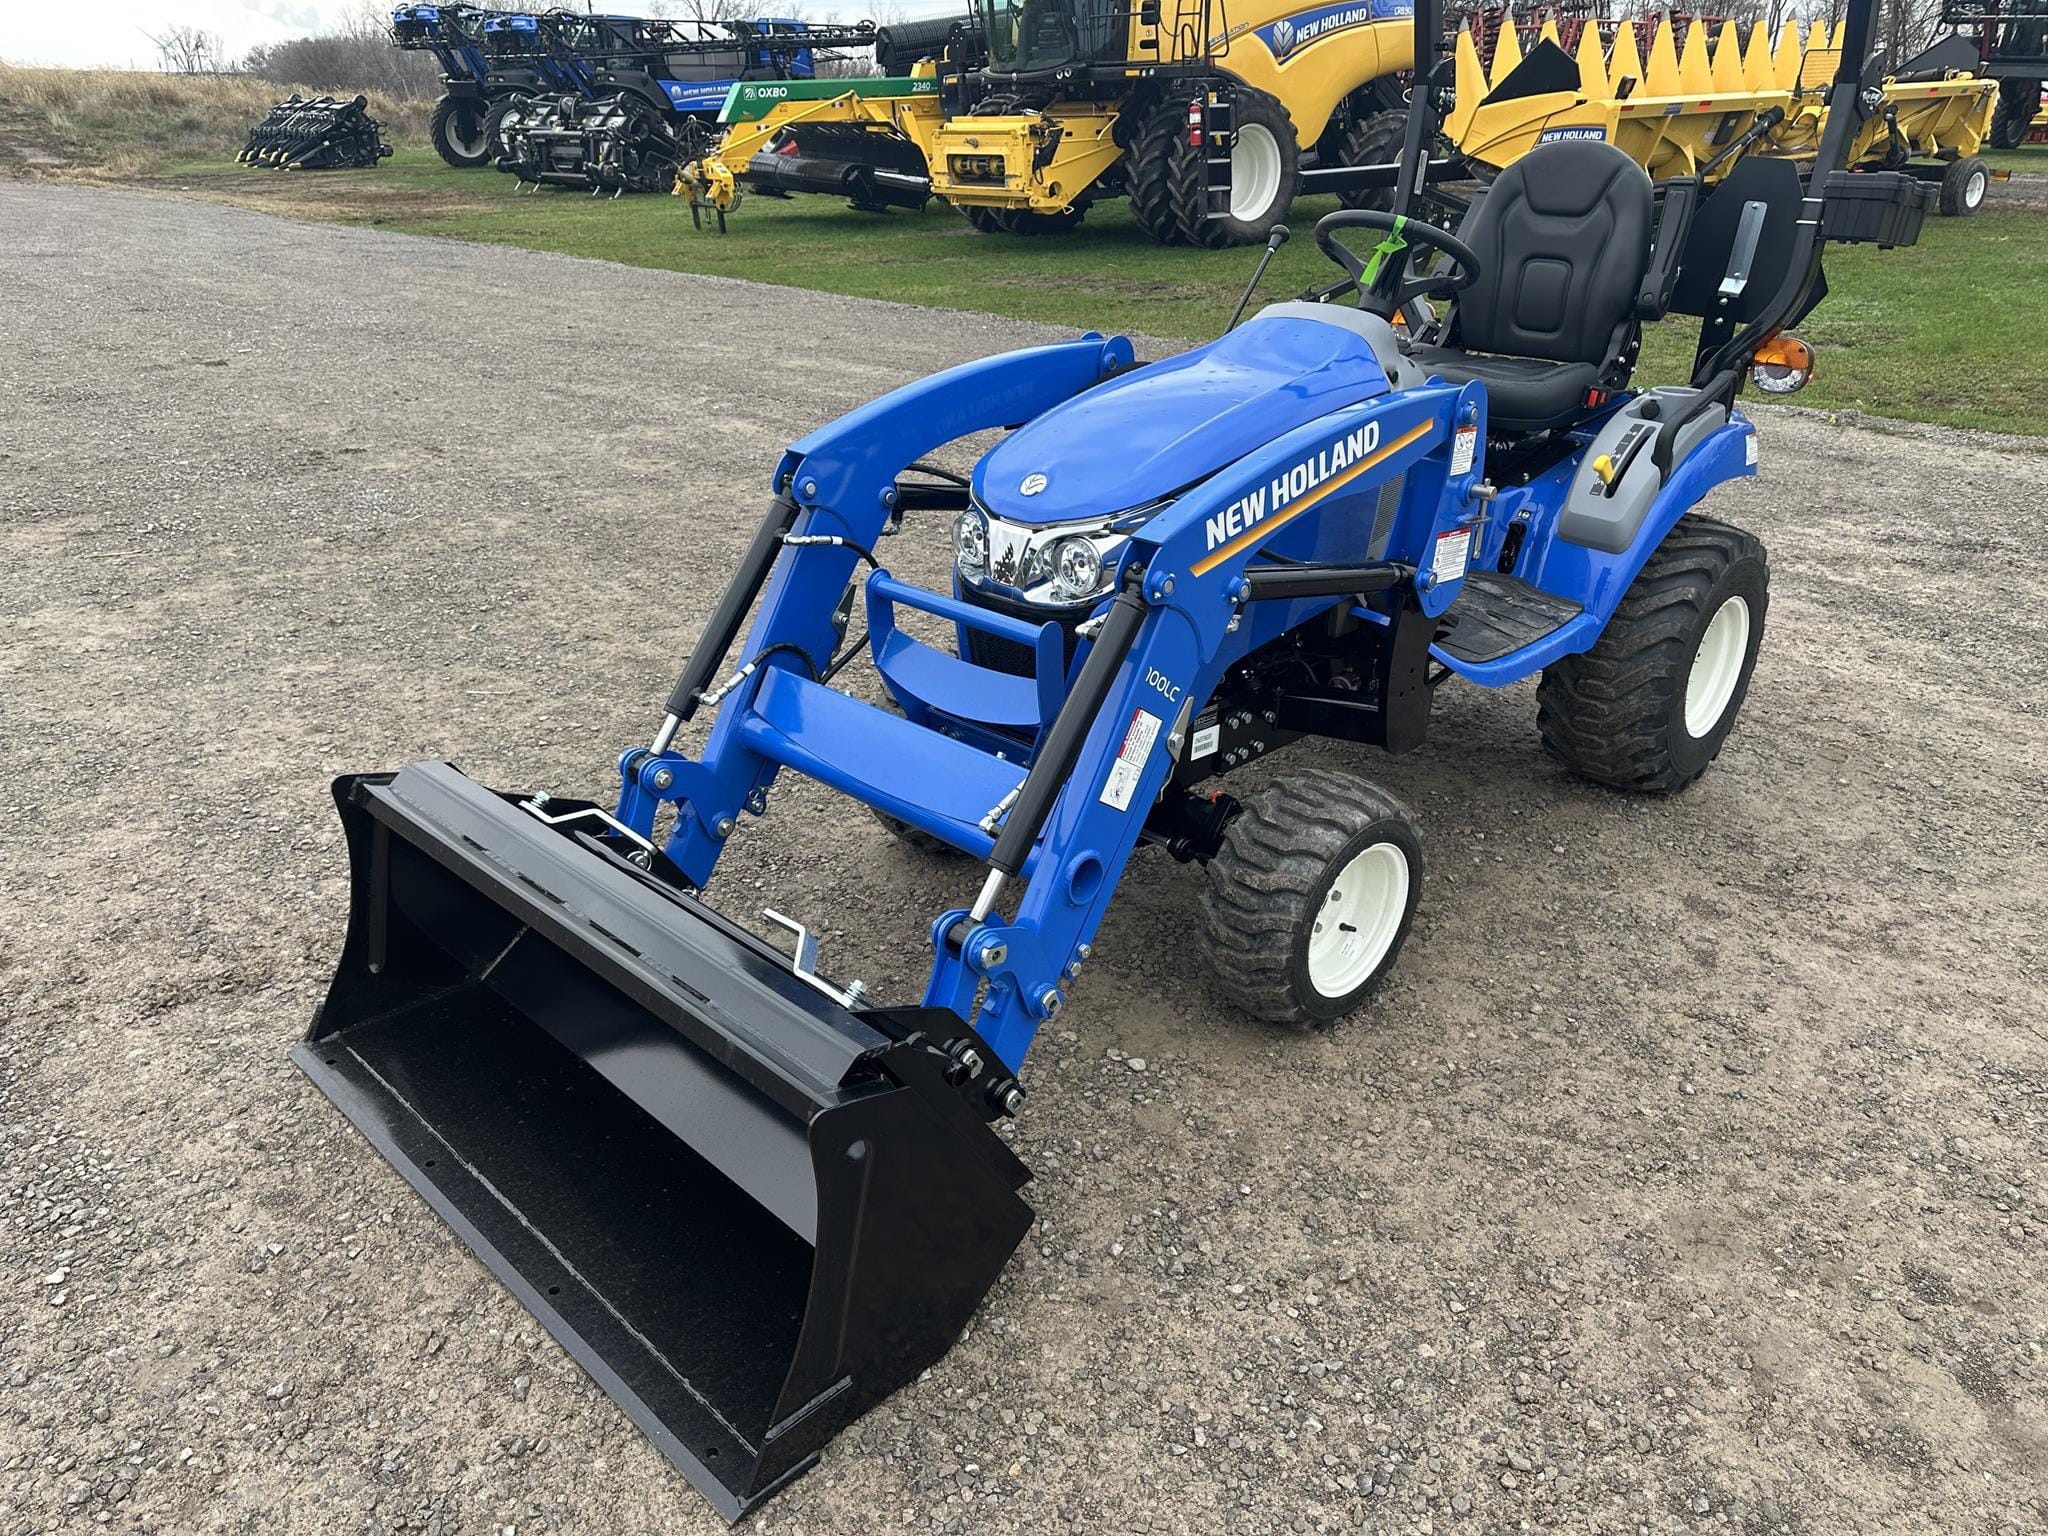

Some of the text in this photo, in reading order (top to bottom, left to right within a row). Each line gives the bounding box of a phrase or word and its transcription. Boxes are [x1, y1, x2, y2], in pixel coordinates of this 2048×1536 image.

[1296, 8, 1367, 44] NEW HOLLAND
[758, 87, 788, 97] OXBO
[912, 82, 931, 91] 2340
[1541, 130, 1603, 143] NEW HOLLAND
[1206, 486, 1266, 551] NEW
[1271, 420, 1380, 511] HOLLAND
[1145, 666, 1180, 702] 100LC
